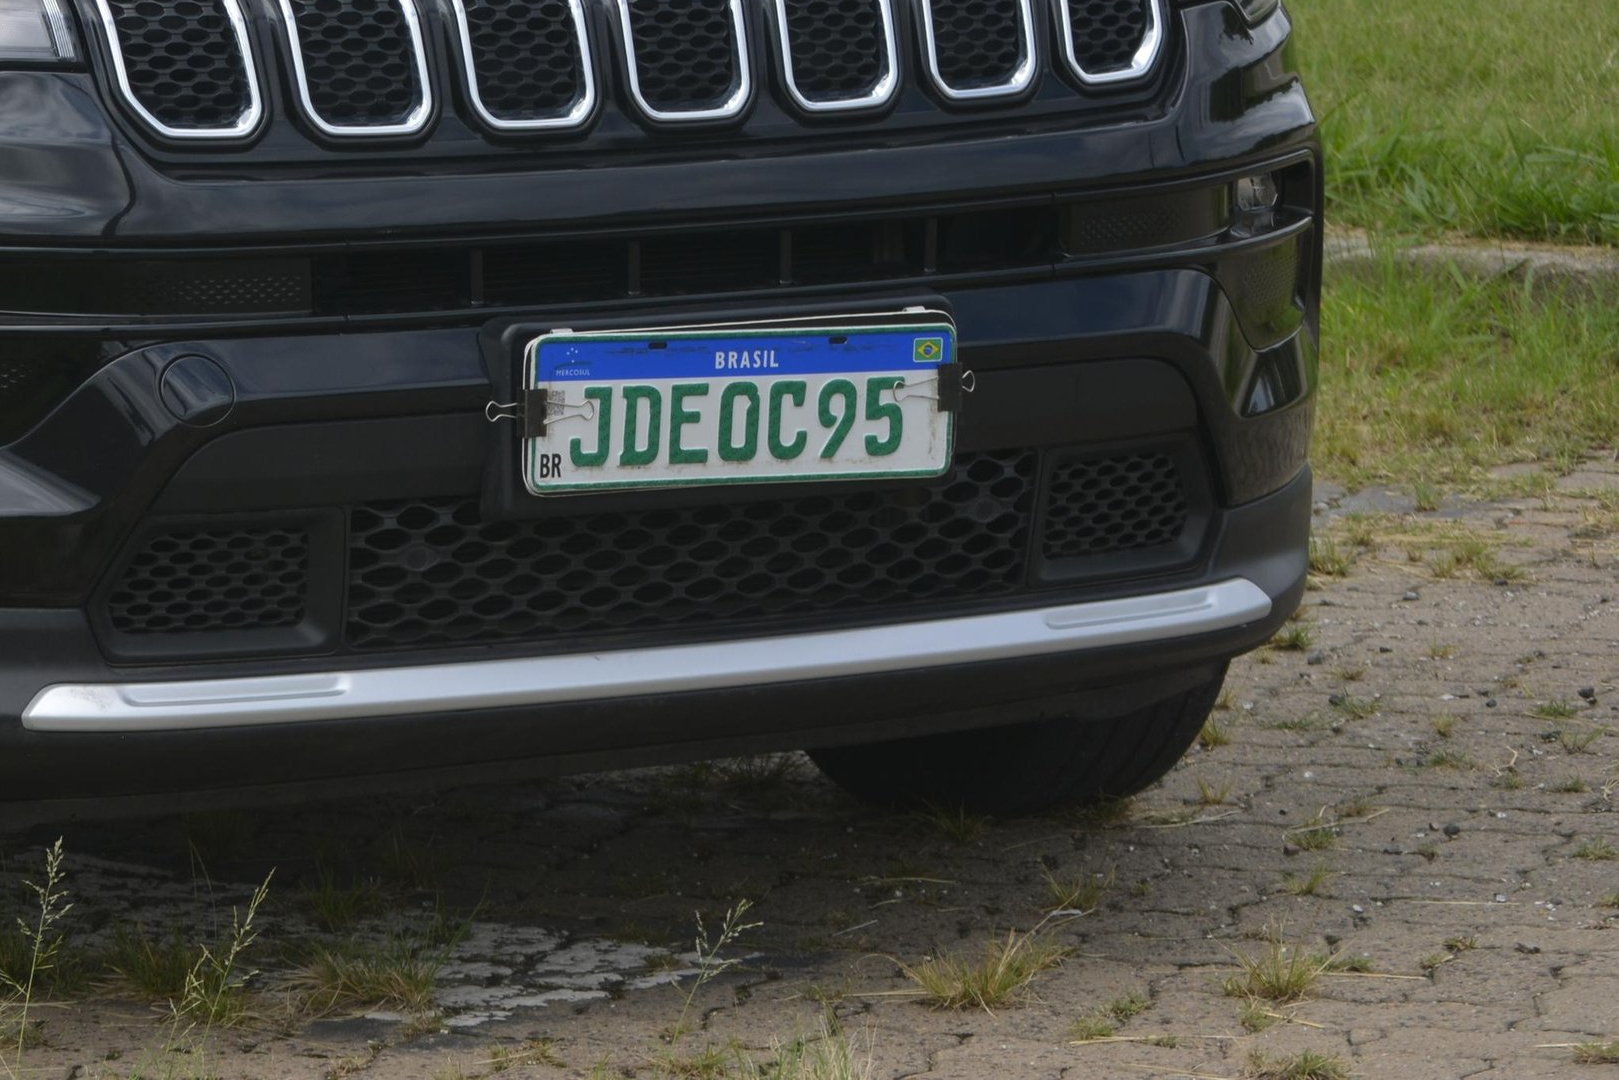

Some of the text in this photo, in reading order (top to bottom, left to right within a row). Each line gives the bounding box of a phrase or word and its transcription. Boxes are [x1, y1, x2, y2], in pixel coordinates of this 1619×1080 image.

[714, 349, 779, 370] BRASIL
[555, 368, 591, 377] MERCOSUL
[539, 453, 562, 478] BR
